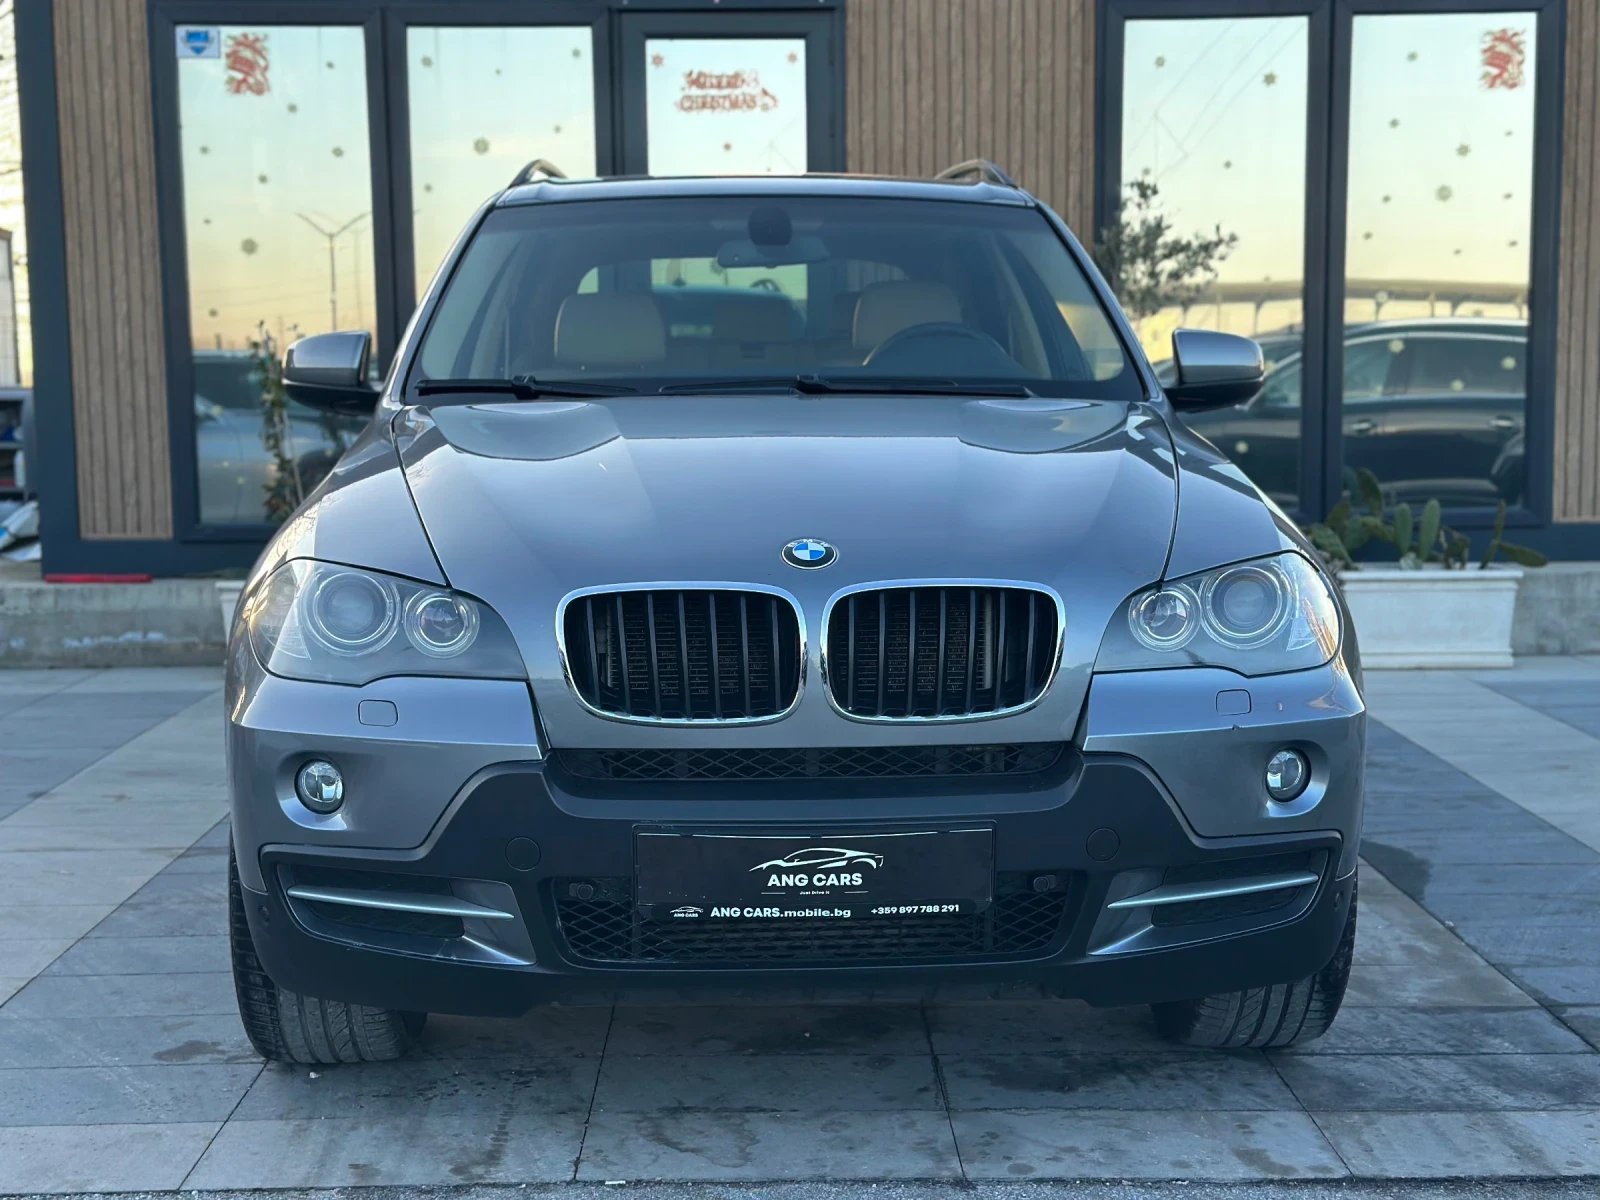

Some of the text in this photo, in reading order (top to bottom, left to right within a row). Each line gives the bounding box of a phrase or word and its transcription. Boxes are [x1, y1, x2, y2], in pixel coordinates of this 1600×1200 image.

[767, 872, 863, 887] ANG CARS
[710, 906, 852, 919] ANG CARS.mobile.bg
[870, 904, 960, 915] +359 897 788 291
